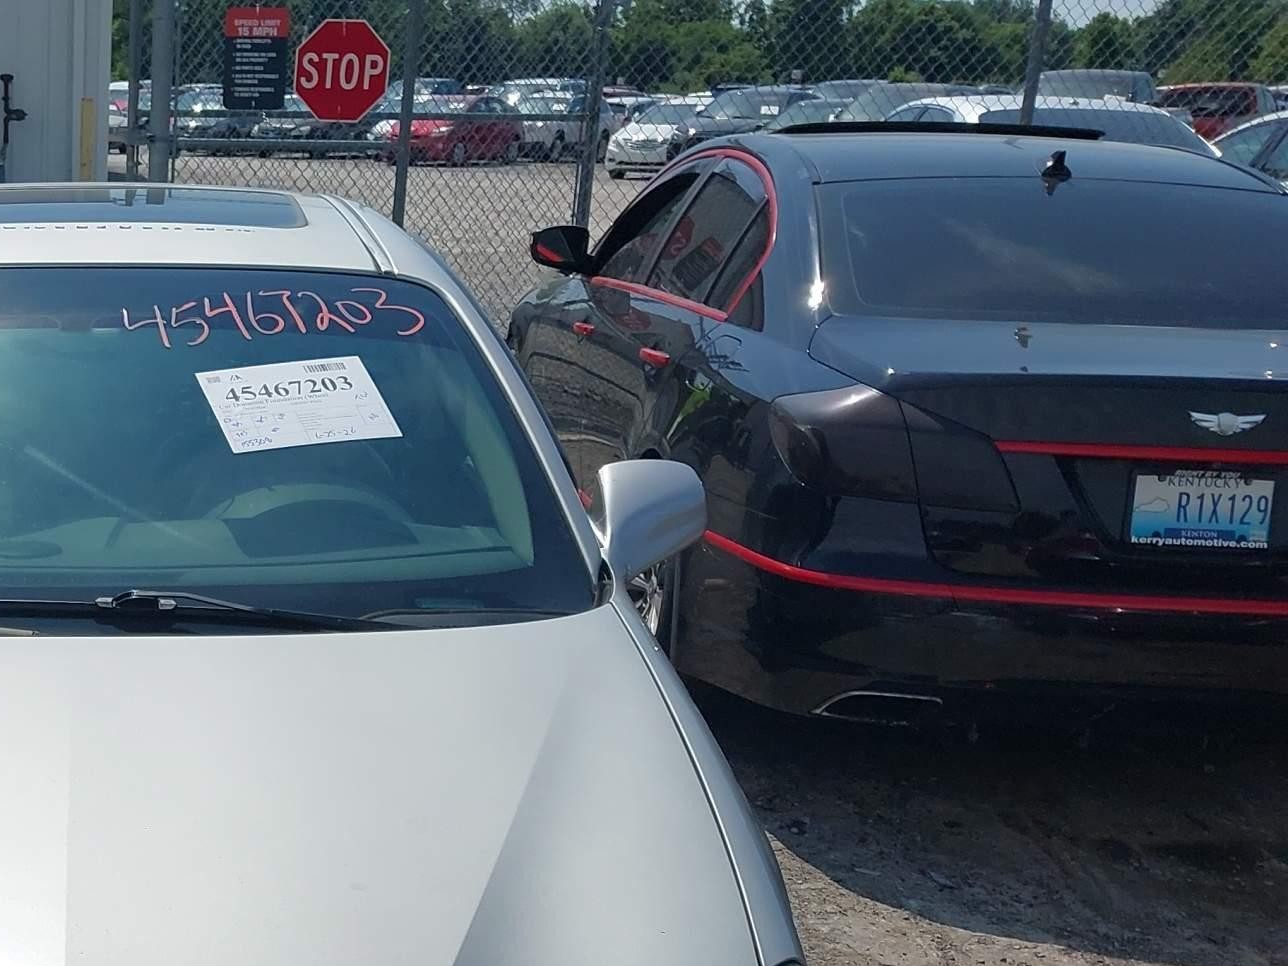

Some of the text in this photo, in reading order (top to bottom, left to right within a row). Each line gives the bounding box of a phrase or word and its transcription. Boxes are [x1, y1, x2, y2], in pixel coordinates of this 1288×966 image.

[237, 27, 278, 36] 15 MPH
[300, 52, 385, 91] STOP
[121, 288, 425, 348] 45467203
[225, 374, 354, 402] 45467203
[1167, 476, 1243, 489] KENTUCKY
[1175, 491, 1270, 526] R1X129
[1130, 535, 1269, 549] kerryautomotive.com
[1180, 529, 1219, 539] KENTON
